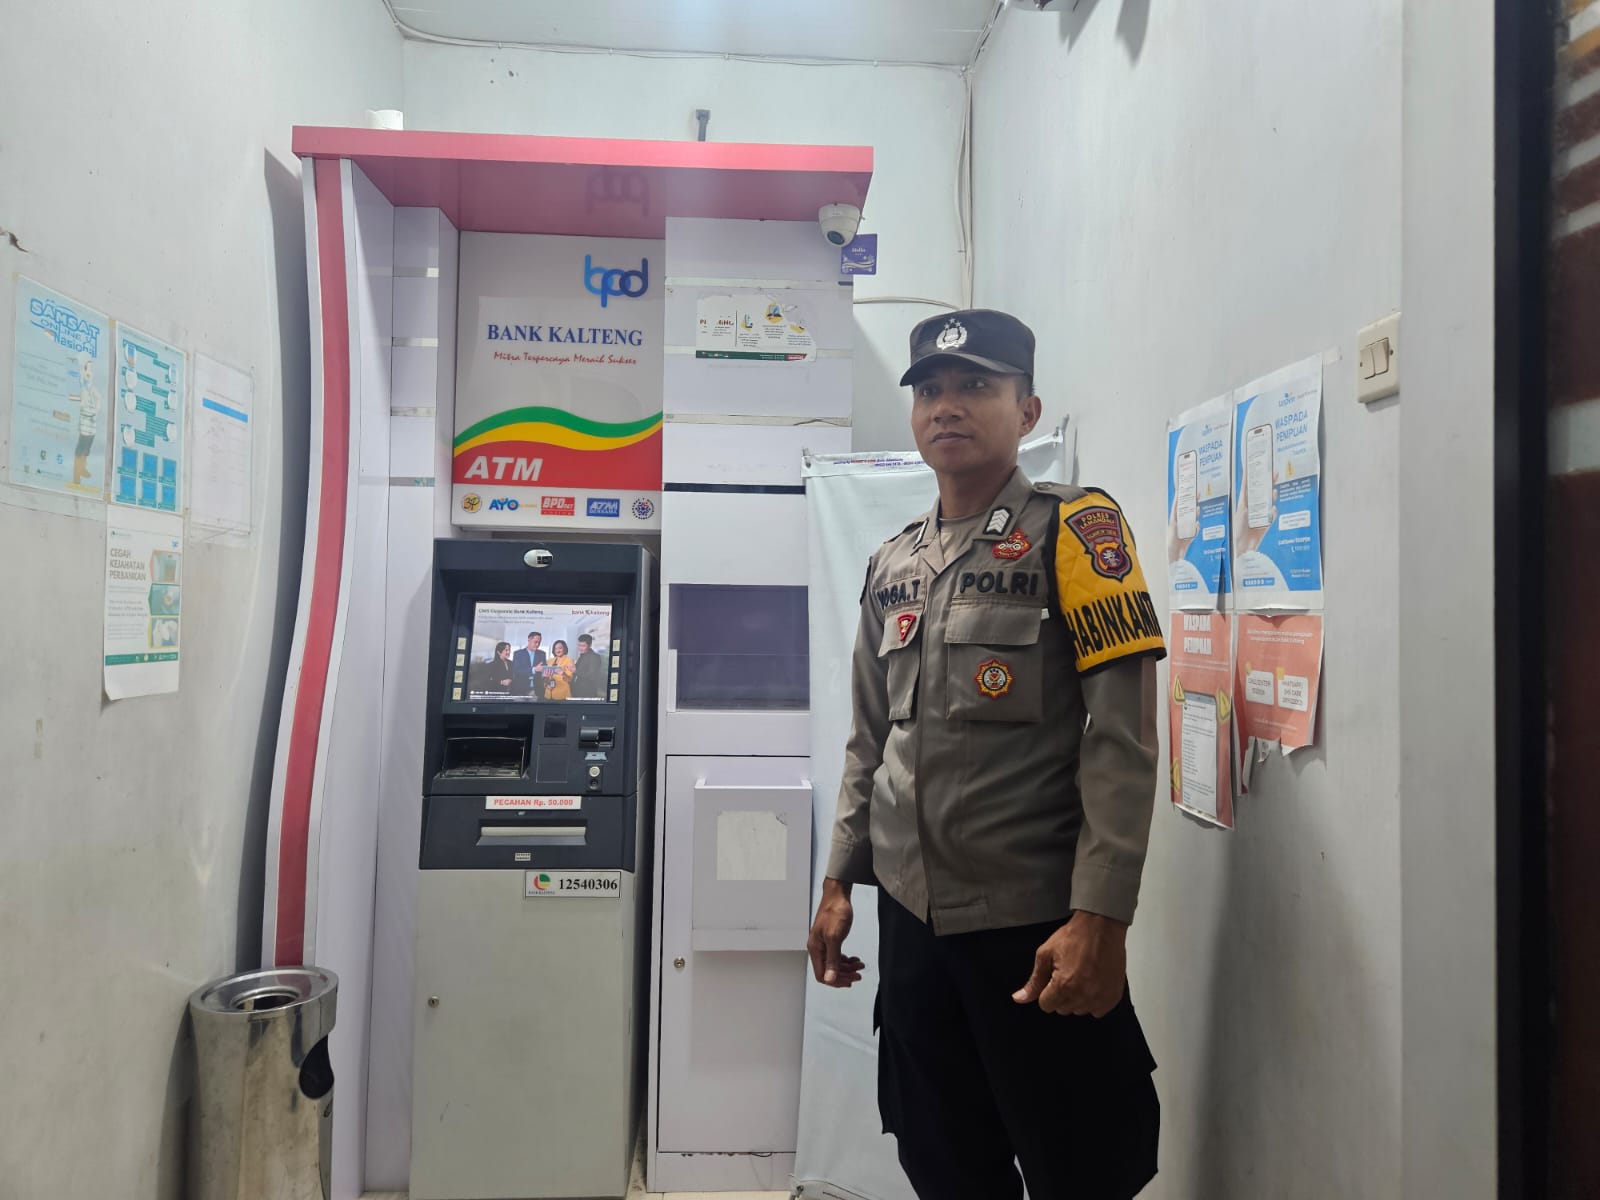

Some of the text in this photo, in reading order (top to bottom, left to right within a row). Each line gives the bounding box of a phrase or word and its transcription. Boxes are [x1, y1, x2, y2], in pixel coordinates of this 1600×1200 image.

[584, 254, 649, 308] bpd
[30, 297, 101, 339] SAMSAT
[487, 324, 643, 347] BANK KALTENG
[493, 351, 637, 366] Mitra Terpercaya Meraih Sukses
[1275, 409, 1309, 430] WASPADA
[464, 455, 544, 482] ATM
[488, 496, 520, 512] AYO
[110, 548, 132, 559] CEGAH
[110, 560, 146, 571] KEJAHATAN
[110, 570, 146, 582] PERBANKAN
[959, 570, 1039, 596] POLRI
[493, 798, 532, 806] PECAHAN
[533, 799, 546, 808] Rp.
[558, 877, 618, 890] 12540306
